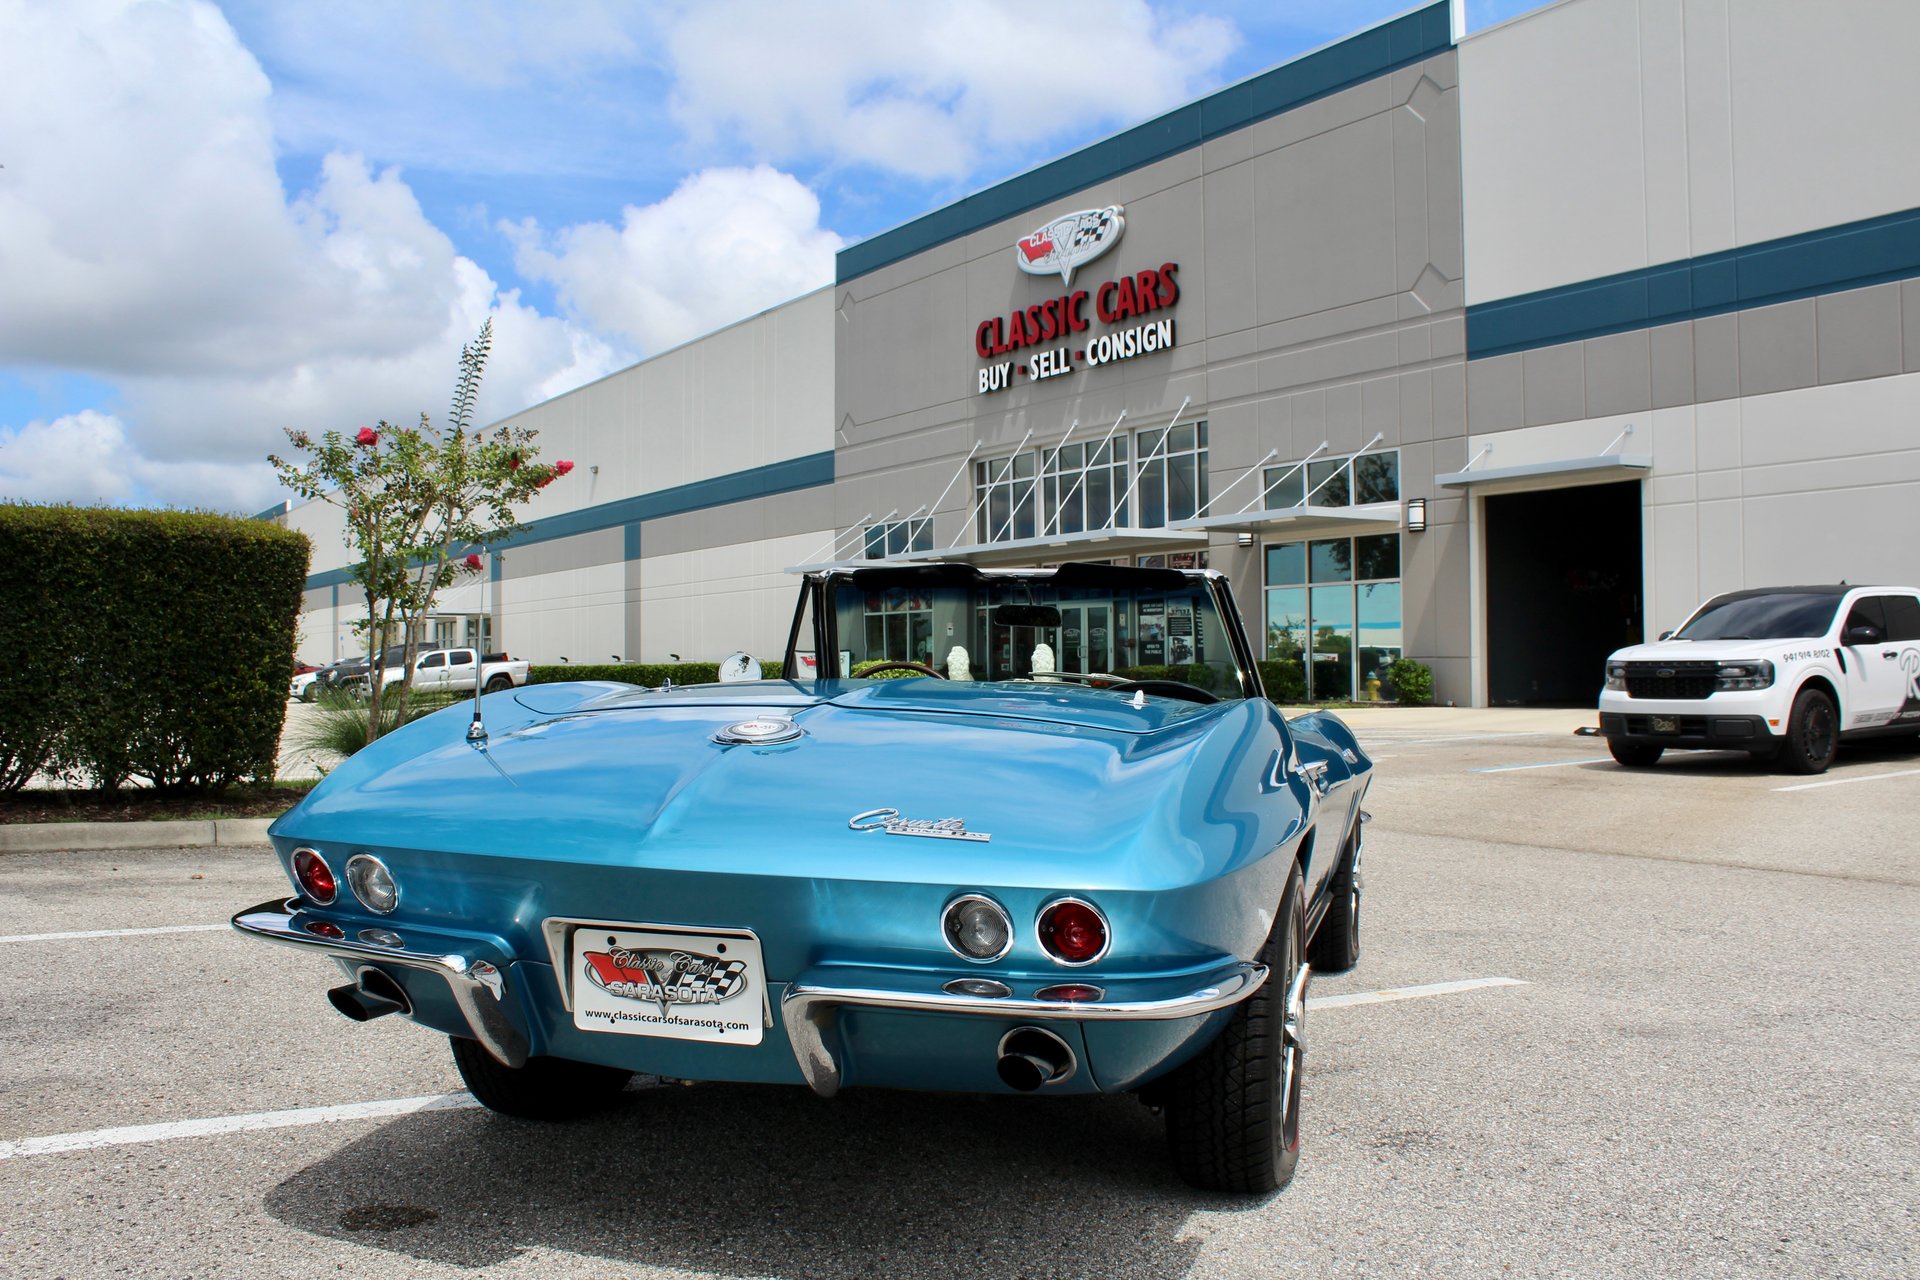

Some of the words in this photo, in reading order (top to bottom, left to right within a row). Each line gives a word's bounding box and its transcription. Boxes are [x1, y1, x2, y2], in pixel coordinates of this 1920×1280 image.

[1029, 222, 1070, 248] CLASSIC
[1073, 213, 1100, 231] CARS
[976, 291, 1087, 358] CLASSIC
[1096, 262, 1178, 324] CARS
[979, 362, 1011, 393] BUY
[1030, 348, 1071, 381] SELL
[1086, 319, 1173, 366] CONSIGN
[1783, 652, 1798, 663] 941
[608, 945, 664, 972] Classic
[669, 951, 713, 974] Cars
[610, 980, 720, 1005] SARASOTA
[585, 1009, 749, 1031] www.classiccarsofsarasota.com
